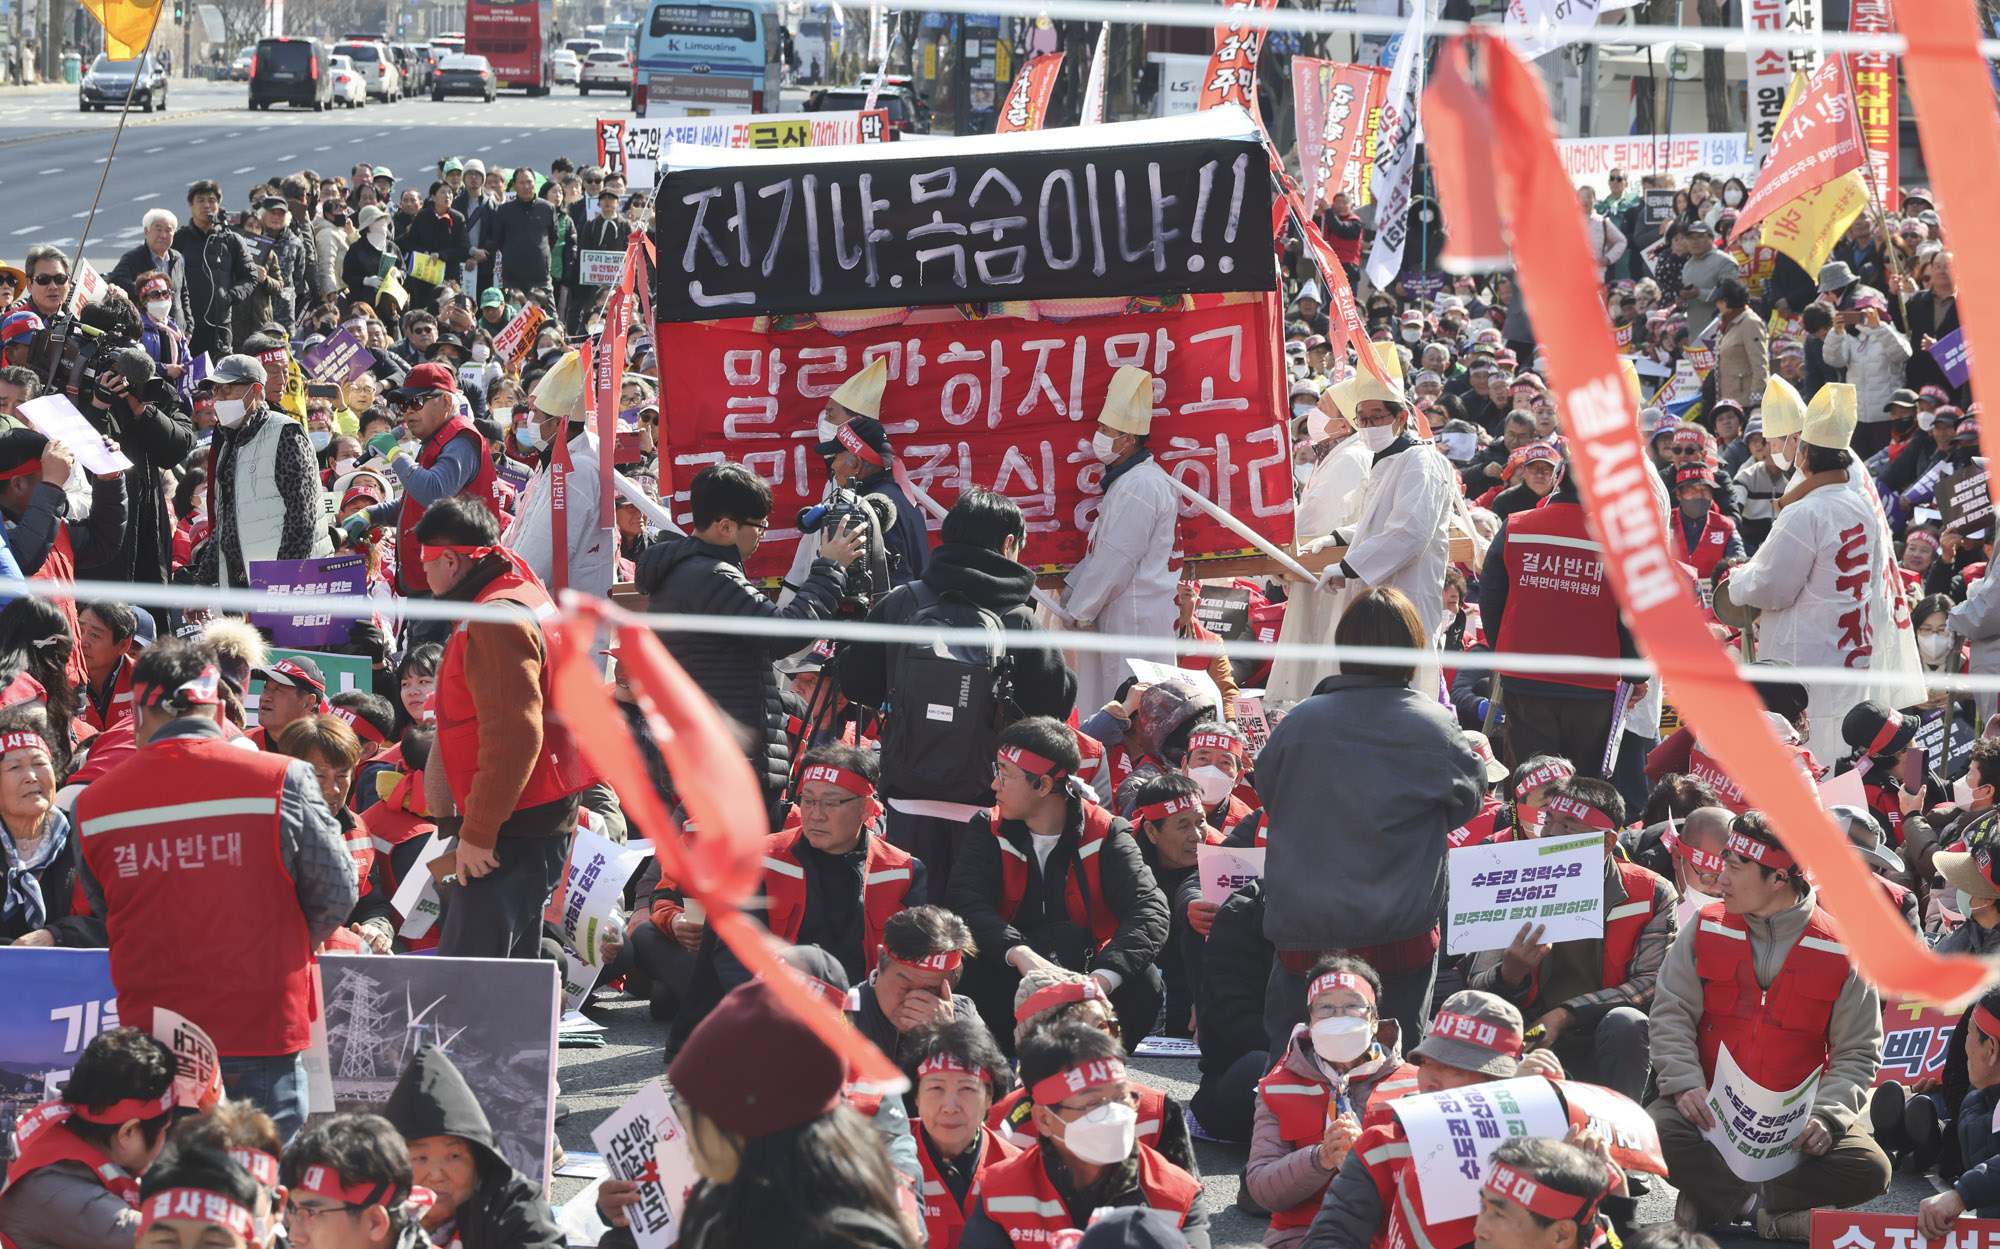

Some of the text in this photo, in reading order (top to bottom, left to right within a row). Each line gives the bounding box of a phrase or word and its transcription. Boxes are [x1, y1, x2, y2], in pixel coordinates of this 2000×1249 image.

[684, 41, 737, 52] Limousine
[1171, 81, 1189, 92] LS
[1710, 531, 1724, 545] 쟁
[1522, 552, 1604, 582] 결사반대
[1519, 574, 1600, 597] 신북면대책위원회
[292, 613, 331, 627] 무효다!
[958, 675, 971, 708] THULE
[113, 832, 243, 879] 결사반대
[585, 851, 607, 892] 수도권
[1471, 862, 1583, 888] 수도권 전력수요
[1495, 884, 1558, 904] 분산하고
[1453, 898, 1599, 926] 민주적인 절차 마련하라!
[1724, 1084, 1807, 1129] 수도권 전력수요
[1732, 1115, 1789, 1144] 분산하고
[1446, 1117, 1481, 1180] 수도권
[1736, 1140, 1766, 1160] 절차
[153, 1190, 248, 1230] 결사반대
